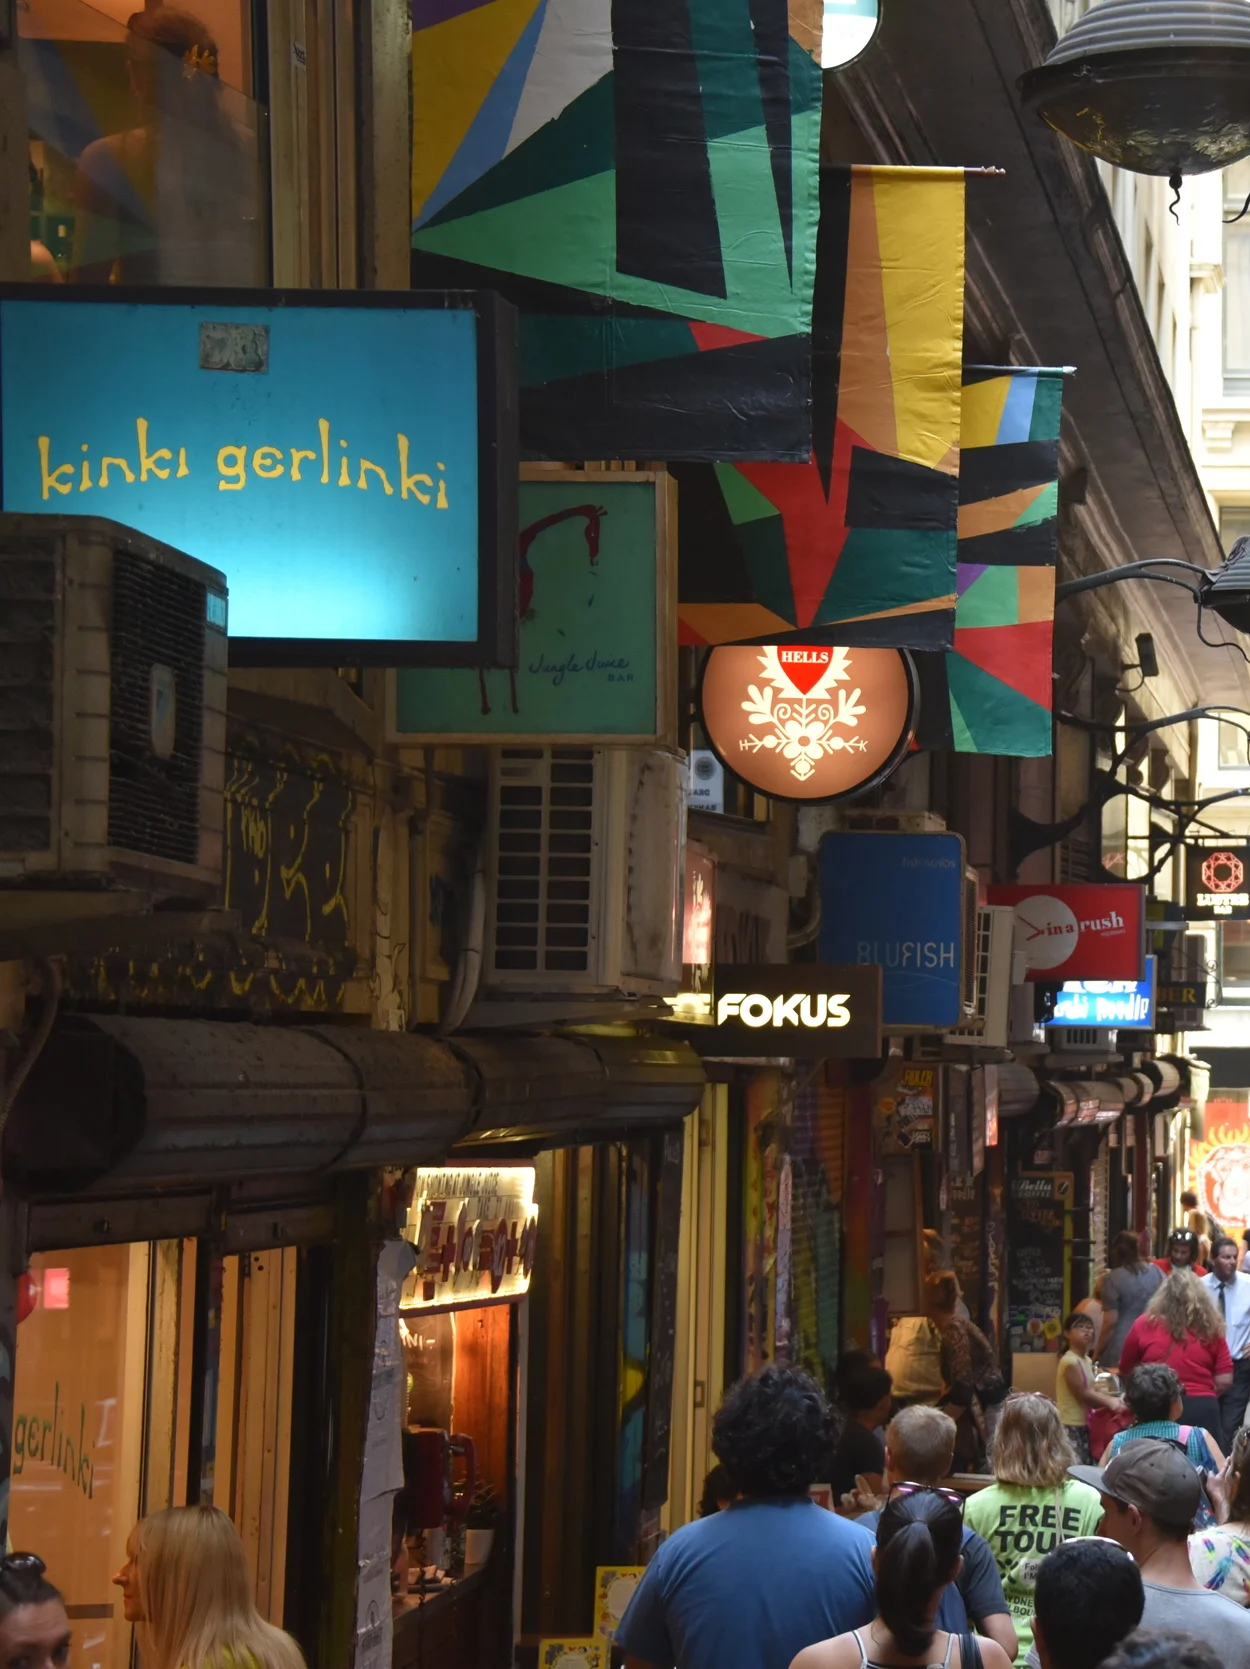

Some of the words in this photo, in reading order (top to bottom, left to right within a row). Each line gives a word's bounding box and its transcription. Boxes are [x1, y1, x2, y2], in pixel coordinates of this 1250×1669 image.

[216, 416, 449, 509] gerlinki
[528, 652, 583, 687] Jungle
[781, 650, 829, 664] HELLS
[607, 673, 634, 682] BAR
[1046, 922, 1063, 936] in
[1065, 924, 1075, 934] a
[1079, 911, 1125, 932] rush
[717, 993, 851, 1028] FOKUS
[12, 1380, 95, 1500] gerlinki
[999, 1504, 1082, 1532] FREE
[995, 1530, 1076, 1554] TOU
